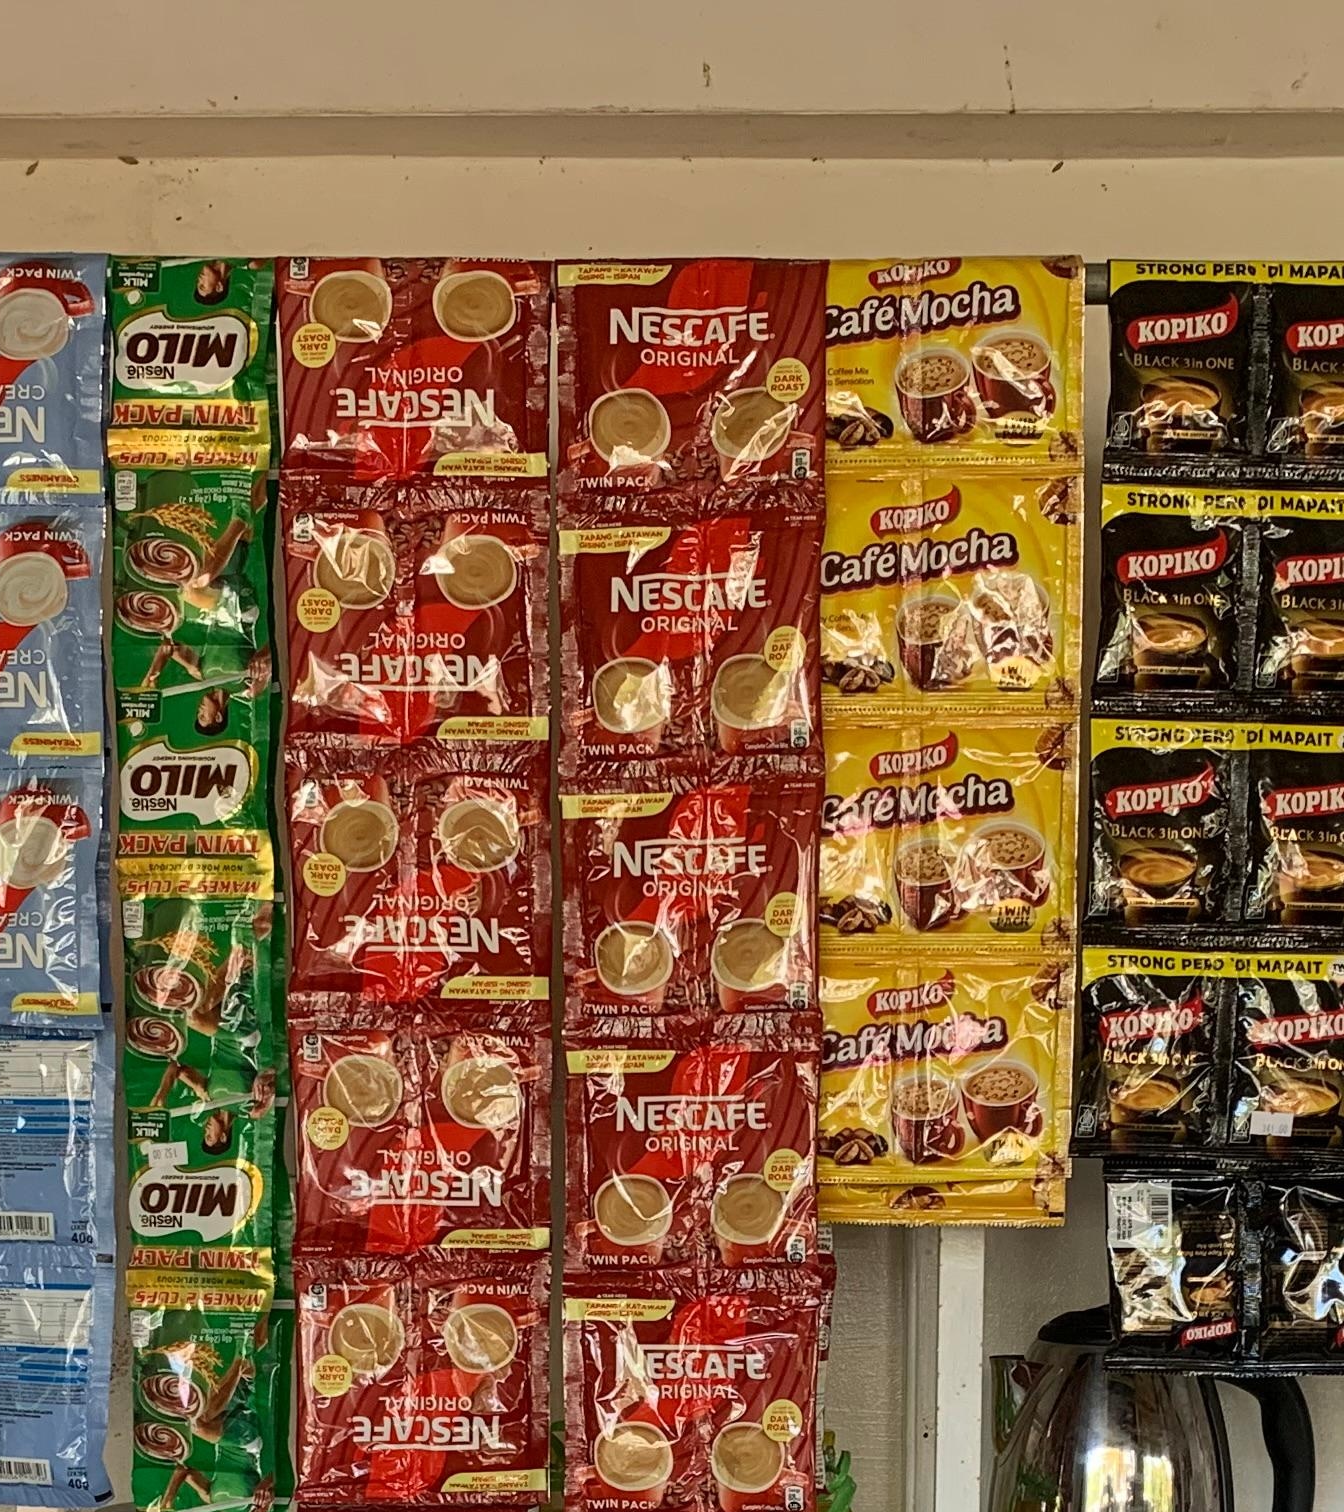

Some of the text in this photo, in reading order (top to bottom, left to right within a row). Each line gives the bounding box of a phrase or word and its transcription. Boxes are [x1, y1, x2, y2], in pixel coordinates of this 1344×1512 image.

[6, 267, 83, 280] TWIN PACK
[876, 258, 951, 284] KOPIKO
[1135, 262, 1207, 277] STRONG
[1212, 262, 1256, 277] PERO
[122, 277, 149, 288] MILK
[900, 282, 1016, 328] Mocha
[1137, 311, 1229, 344] KOPIKO
[125, 332, 238, 368] MILO
[640, 348, 739, 367] ORIGINAL
[1133, 352, 1180, 369] BLACK
[1205, 357, 1235, 370] ONE
[364, 366, 463, 383] ORIGINAL
[773, 374, 803, 383] DARK
[770, 382, 806, 393] ROAST
[114, 403, 259, 427] TWIN PACK
[578, 475, 654, 489] TWIN PACK
[453, 512, 527, 524] TWIN PACK
[878, 499, 950, 532] KOPIKO
[819, 529, 1014, 588] Café Mocha
[876, 744, 949, 776] KOPIKO
[129, 763, 238, 799] MILO
[119, 832, 260, 855] TWIN PACK
[125, 878, 260, 894] MAKES 2 CUPS
[141, 1182, 238, 1217] MILO
